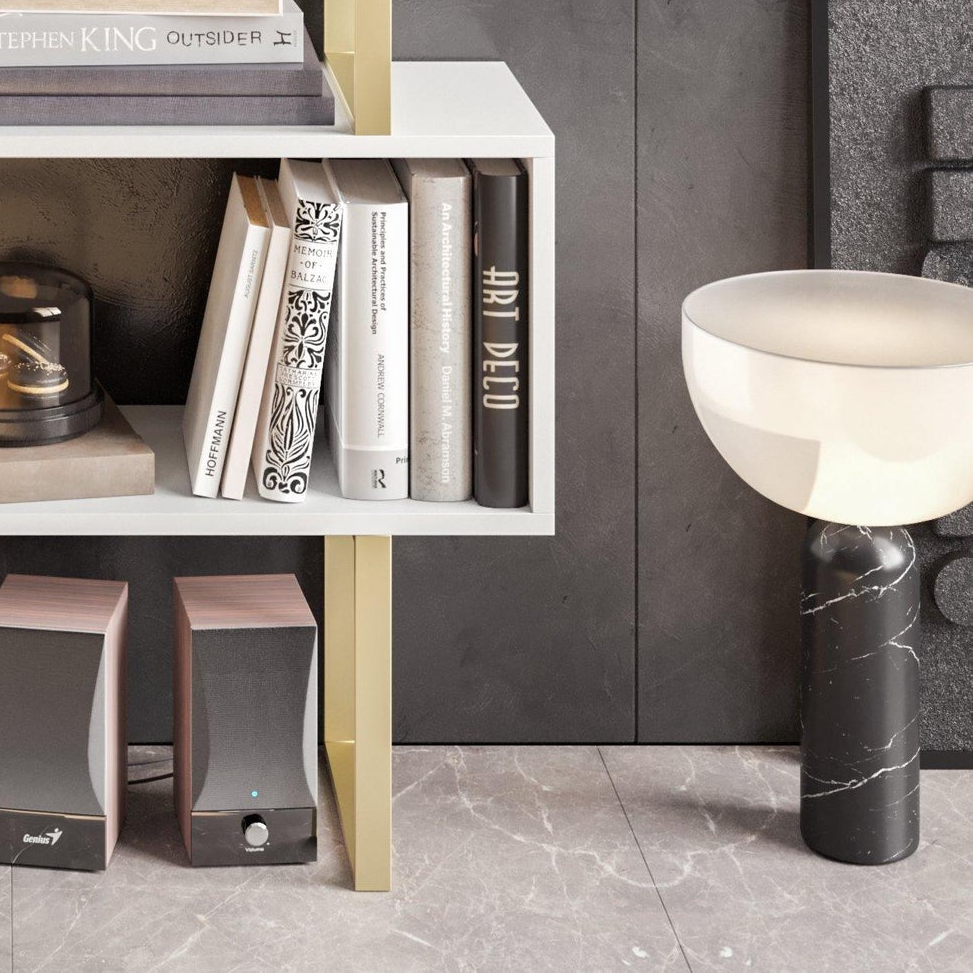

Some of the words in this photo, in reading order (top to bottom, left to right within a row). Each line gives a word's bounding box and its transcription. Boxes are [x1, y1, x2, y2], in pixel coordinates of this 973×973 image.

[80, 26, 157, 53] KING
[166, 30, 263, 47] OUTSIDER
[442, 202, 453, 220] An
[290, 270, 327, 284] BALZAC
[304, 260, 318, 269] OF
[441, 223, 453, 308] Architectural
[380, 303, 387, 311] of
[482, 265, 520, 322] ART
[370, 309, 378, 335] Design
[439, 310, 453, 353] History
[377, 354, 385, 390] ANDREW
[441, 366, 453, 403] Daniel
[482, 342, 520, 409] DECO
[377, 393, 385, 438] CORNWALL
[441, 406, 453, 420] M.
[205, 410, 227, 477] HOFFMANN
[441, 422, 453, 483] Abramson
[22, 833, 50, 845] Genius
